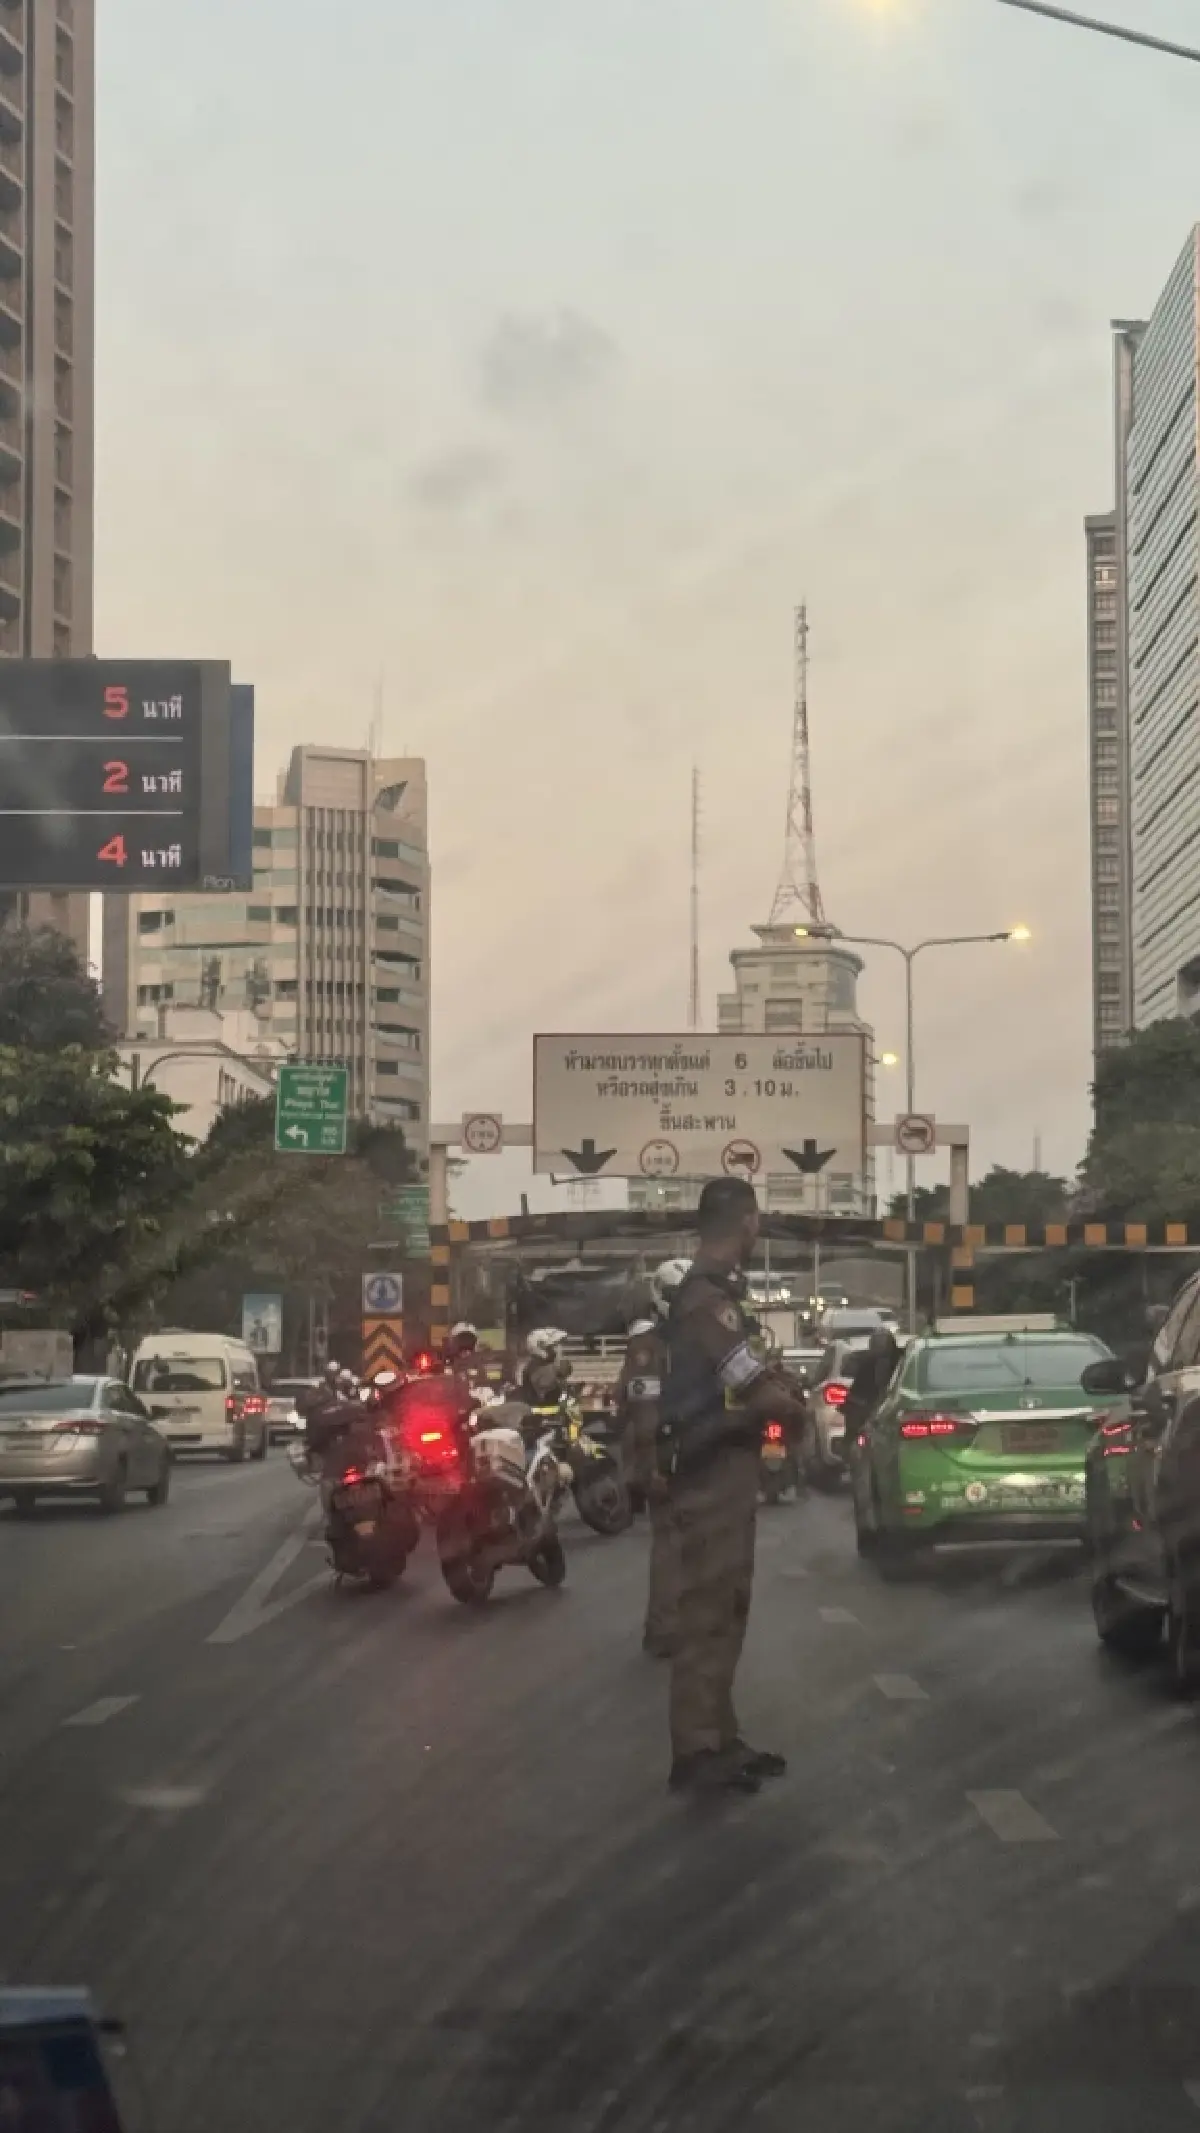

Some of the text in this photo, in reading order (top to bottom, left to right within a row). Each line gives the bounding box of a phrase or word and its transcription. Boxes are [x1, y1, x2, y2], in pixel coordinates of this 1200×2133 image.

[103, 686, 182, 718] 5 นาที
[103, 761, 182, 793] 2 นาที
[97, 834, 181, 867] 4 นาที
[734, 1052, 748, 1070] 6
